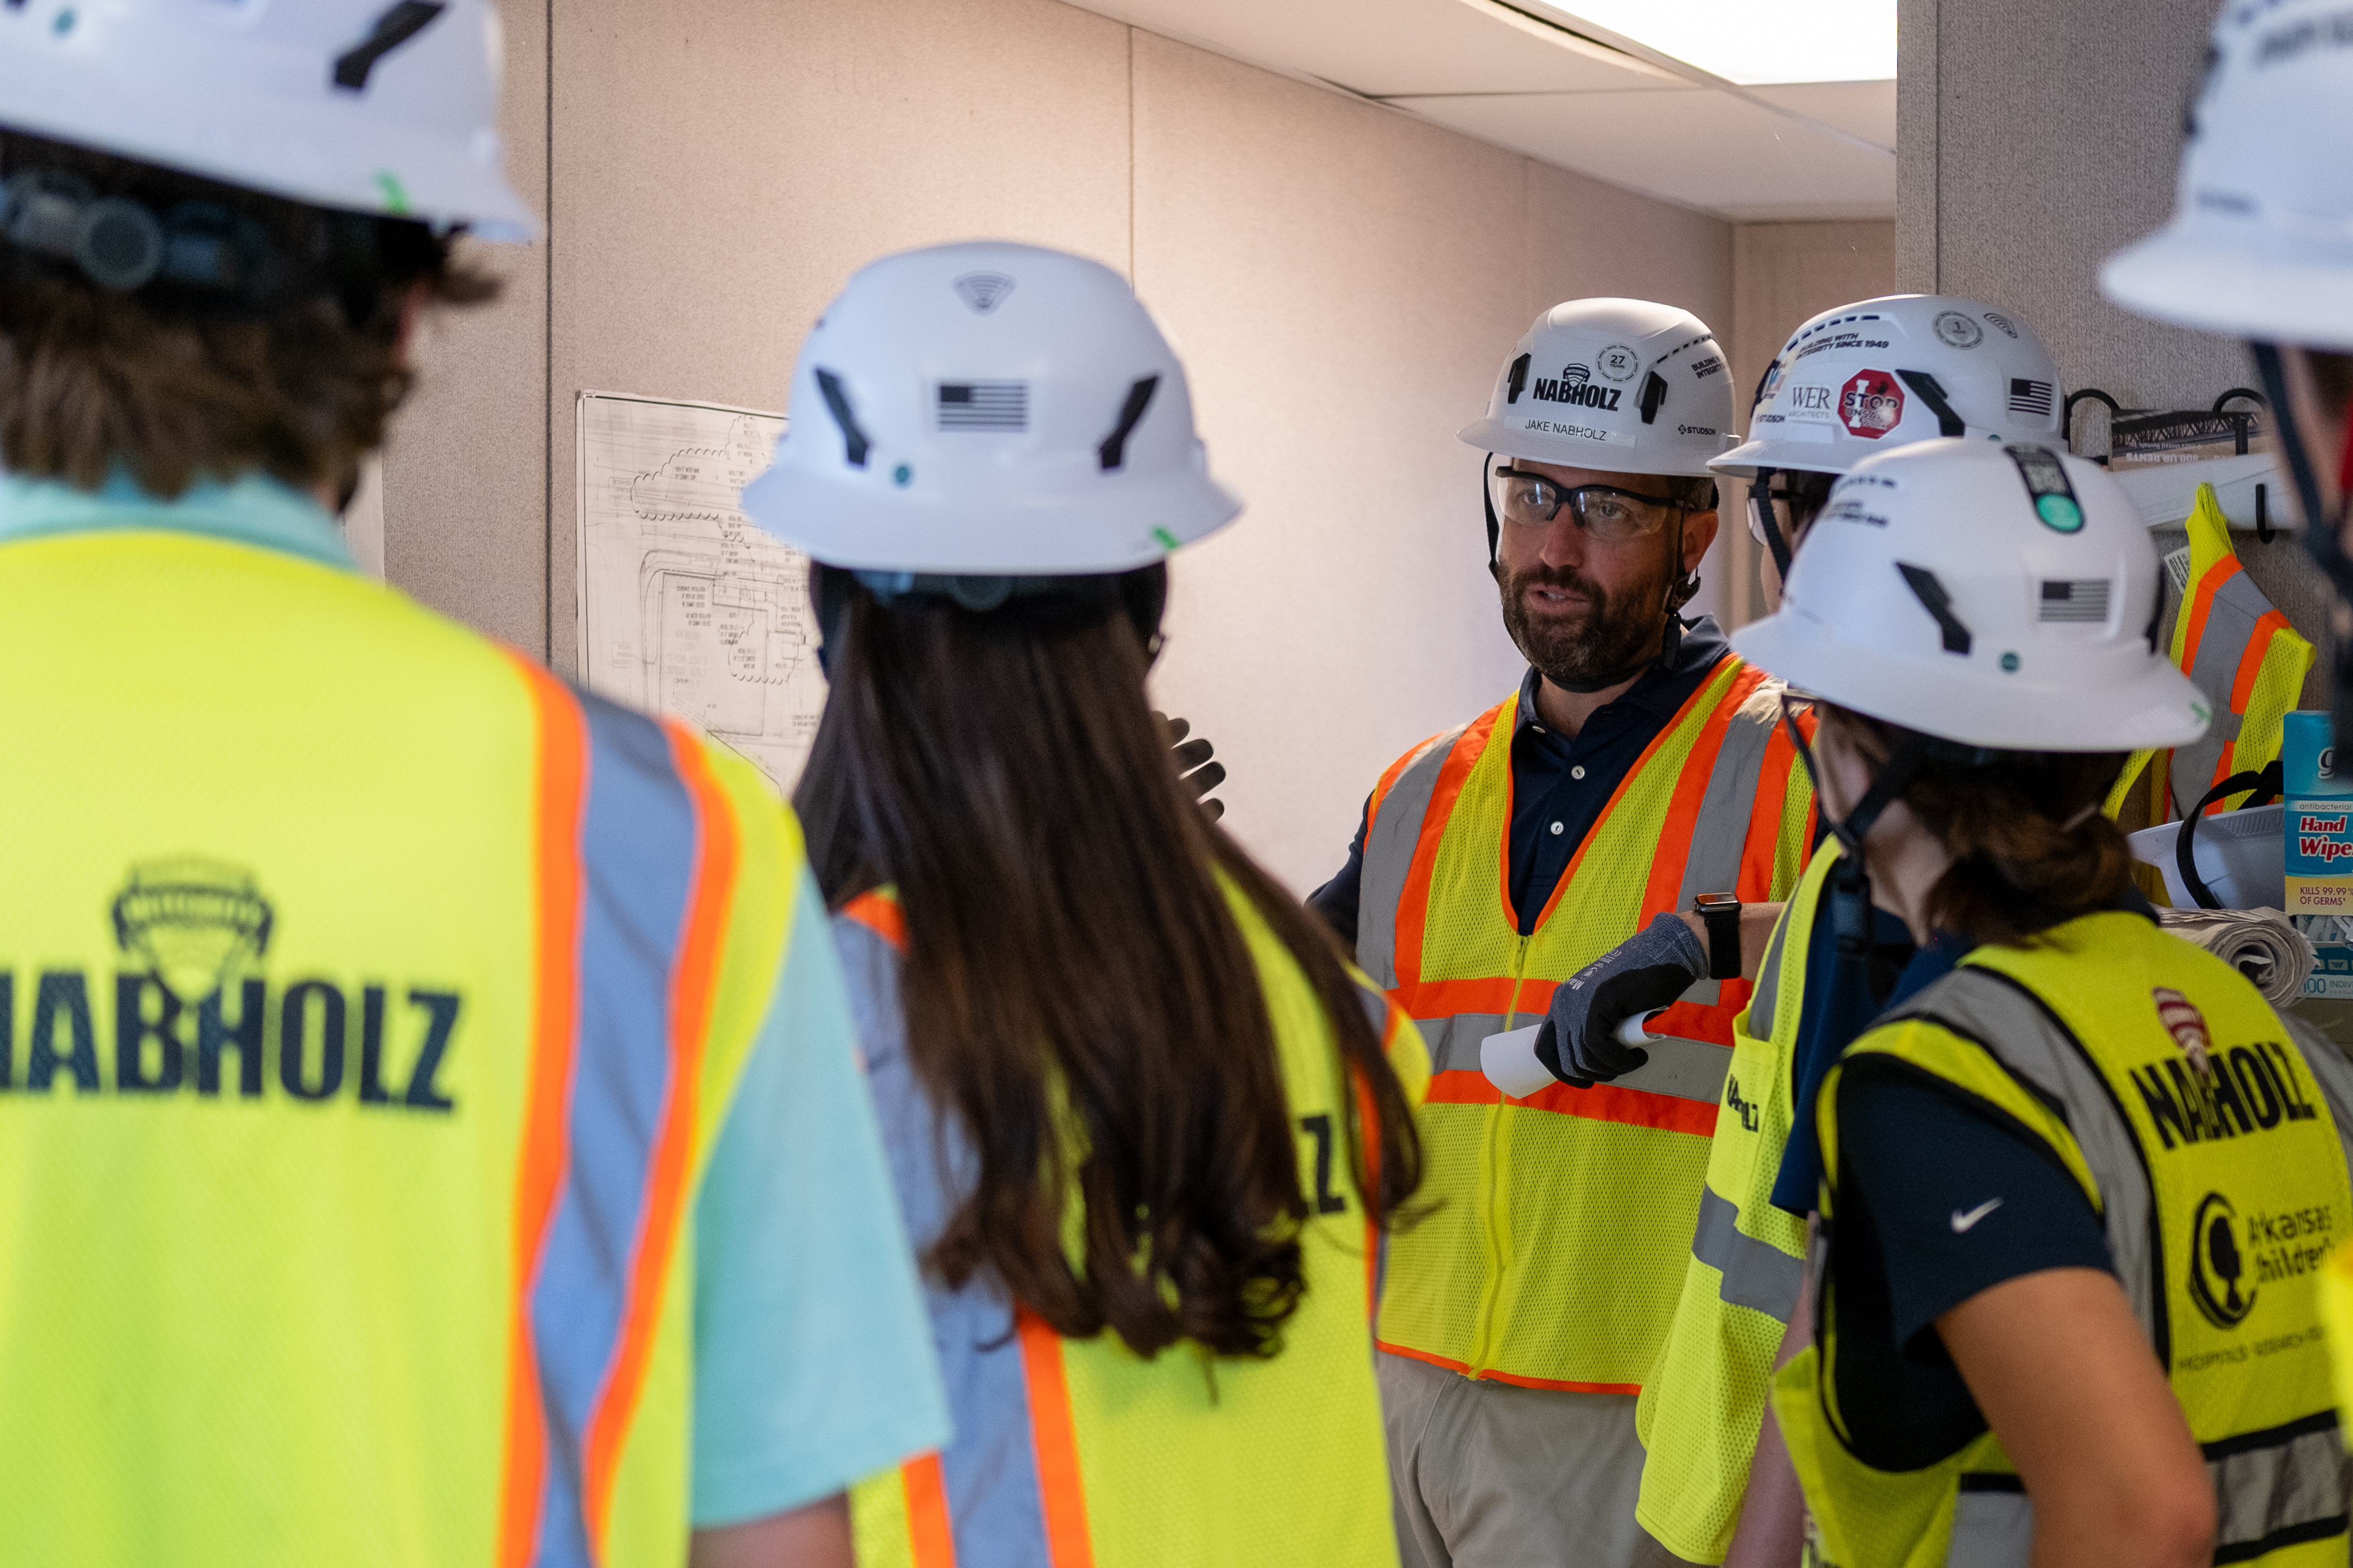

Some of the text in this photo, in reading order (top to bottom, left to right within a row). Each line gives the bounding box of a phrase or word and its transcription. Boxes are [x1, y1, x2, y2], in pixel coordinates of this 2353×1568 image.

[1834, 332, 1859, 341] WITH
[1835, 340, 1863, 348] SINCE
[1865, 340, 1889, 348] 1949
[1610, 355, 1626, 364] 27
[1533, 378, 1622, 412] NABHOLZ
[1793, 387, 1830, 409] WER
[1844, 391, 1898, 410] STOP
[1525, 420, 1606, 441] JAKE NABHOLZ
[1687, 427, 1716, 435] STUDSON
[2300, 816, 2347, 832] Hand
[2300, 836, 2353, 862] Wipe
[2300, 886, 2320, 895] KILLS
[2300, 896, 2312, 905] OF
